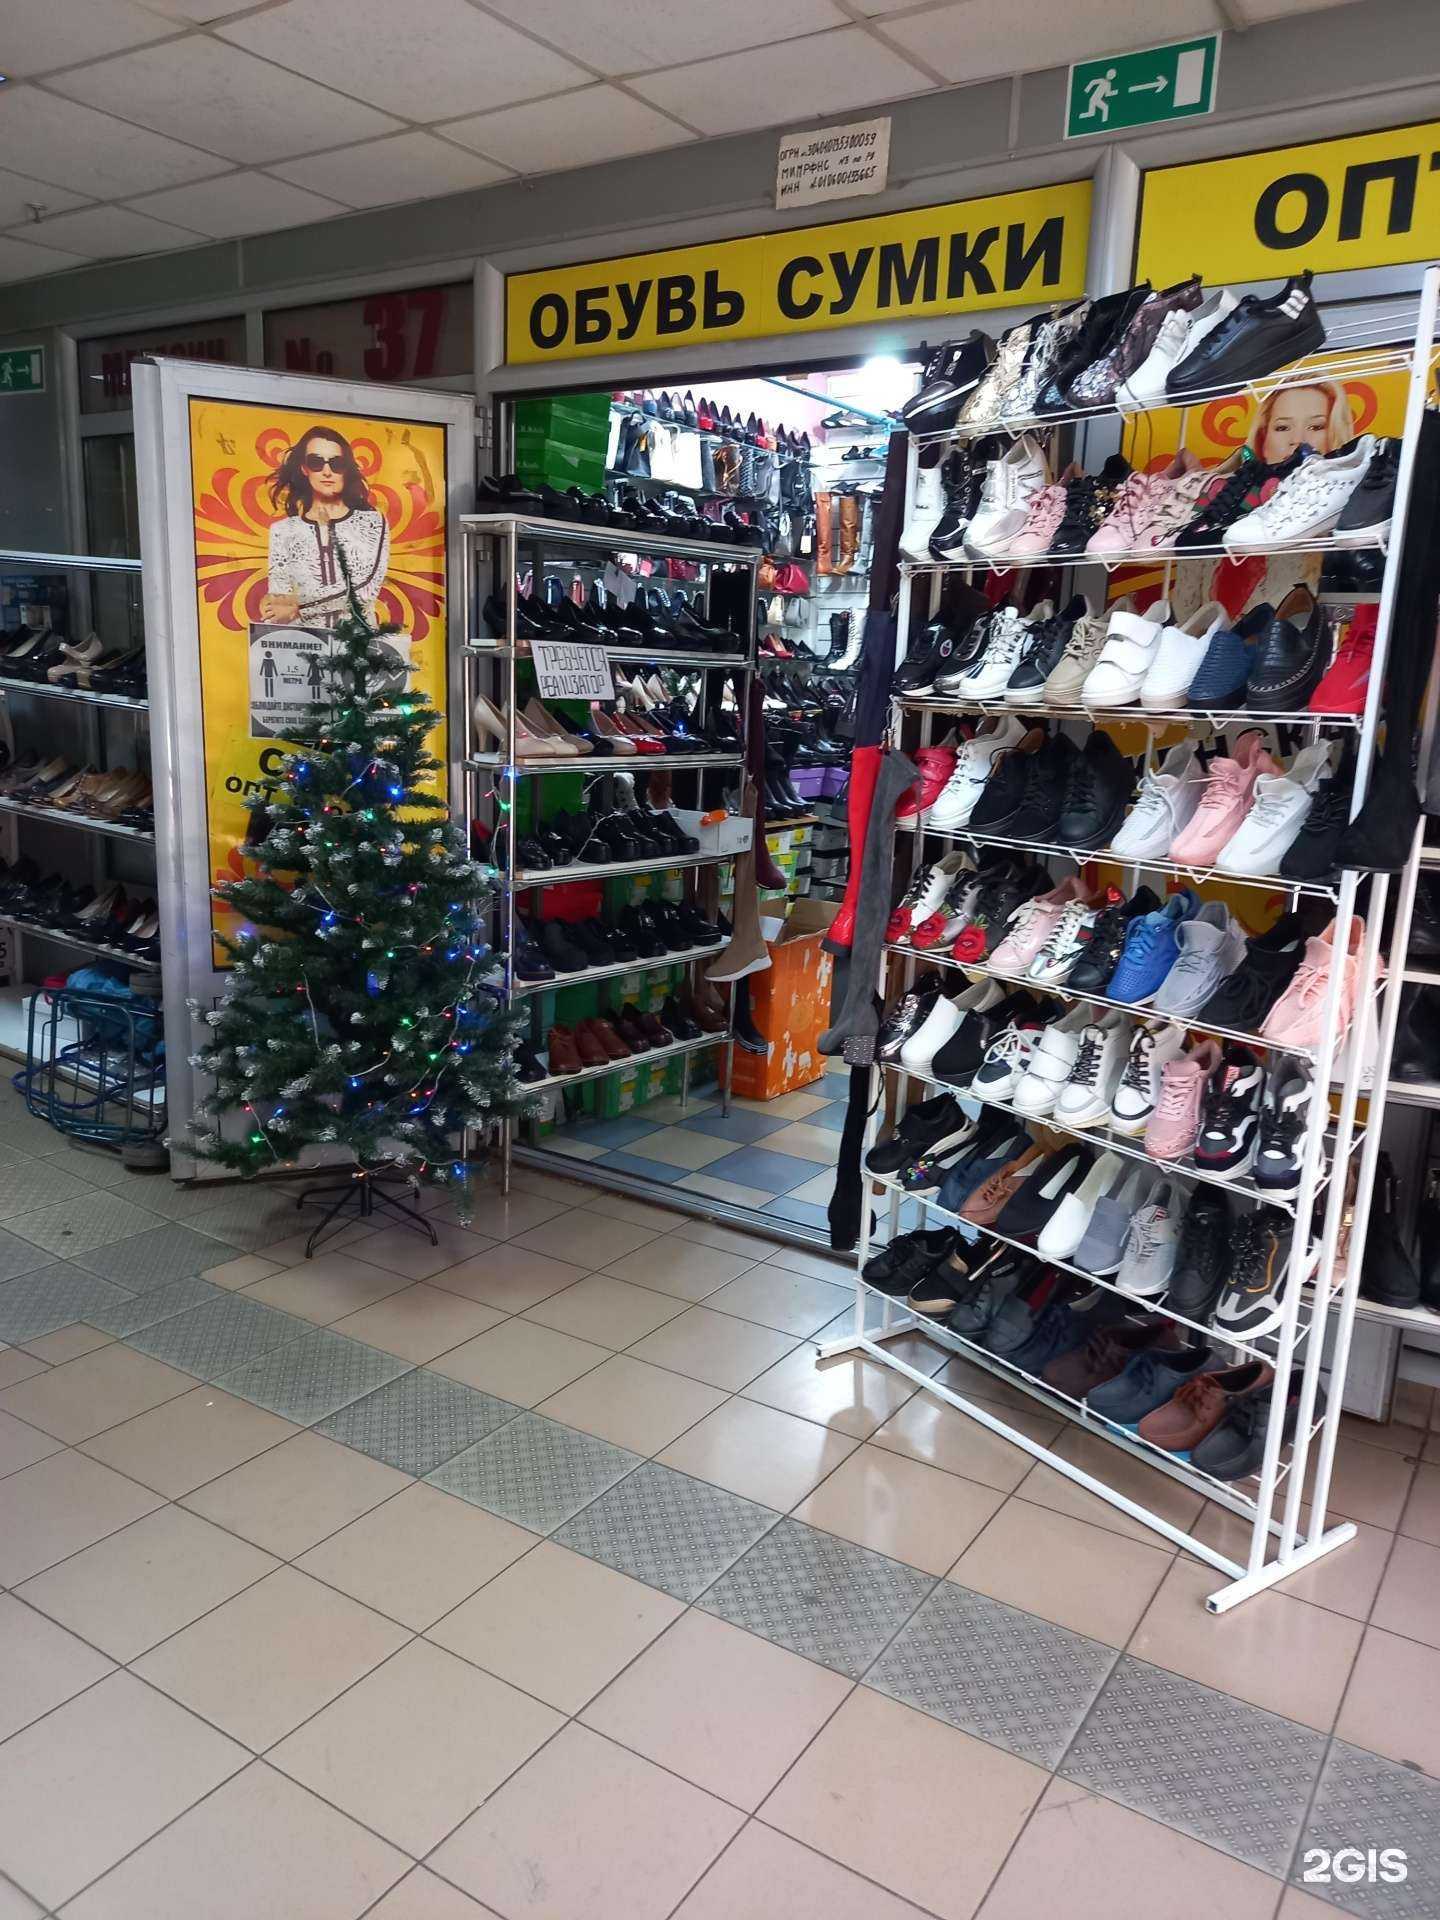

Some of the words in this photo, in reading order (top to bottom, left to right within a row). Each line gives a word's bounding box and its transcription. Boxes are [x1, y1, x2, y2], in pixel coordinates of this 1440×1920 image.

[1255, 151, 1440, 250] ОП
[529, 269, 746, 350] ОБУВЬ
[776, 216, 1066, 320] СУМКИ
[363, 291, 449, 381] 37
[260, 640, 323, 651] ВНИМАНИЕ!
[538, 645, 608, 672] ТРЕБУЕТСЯ
